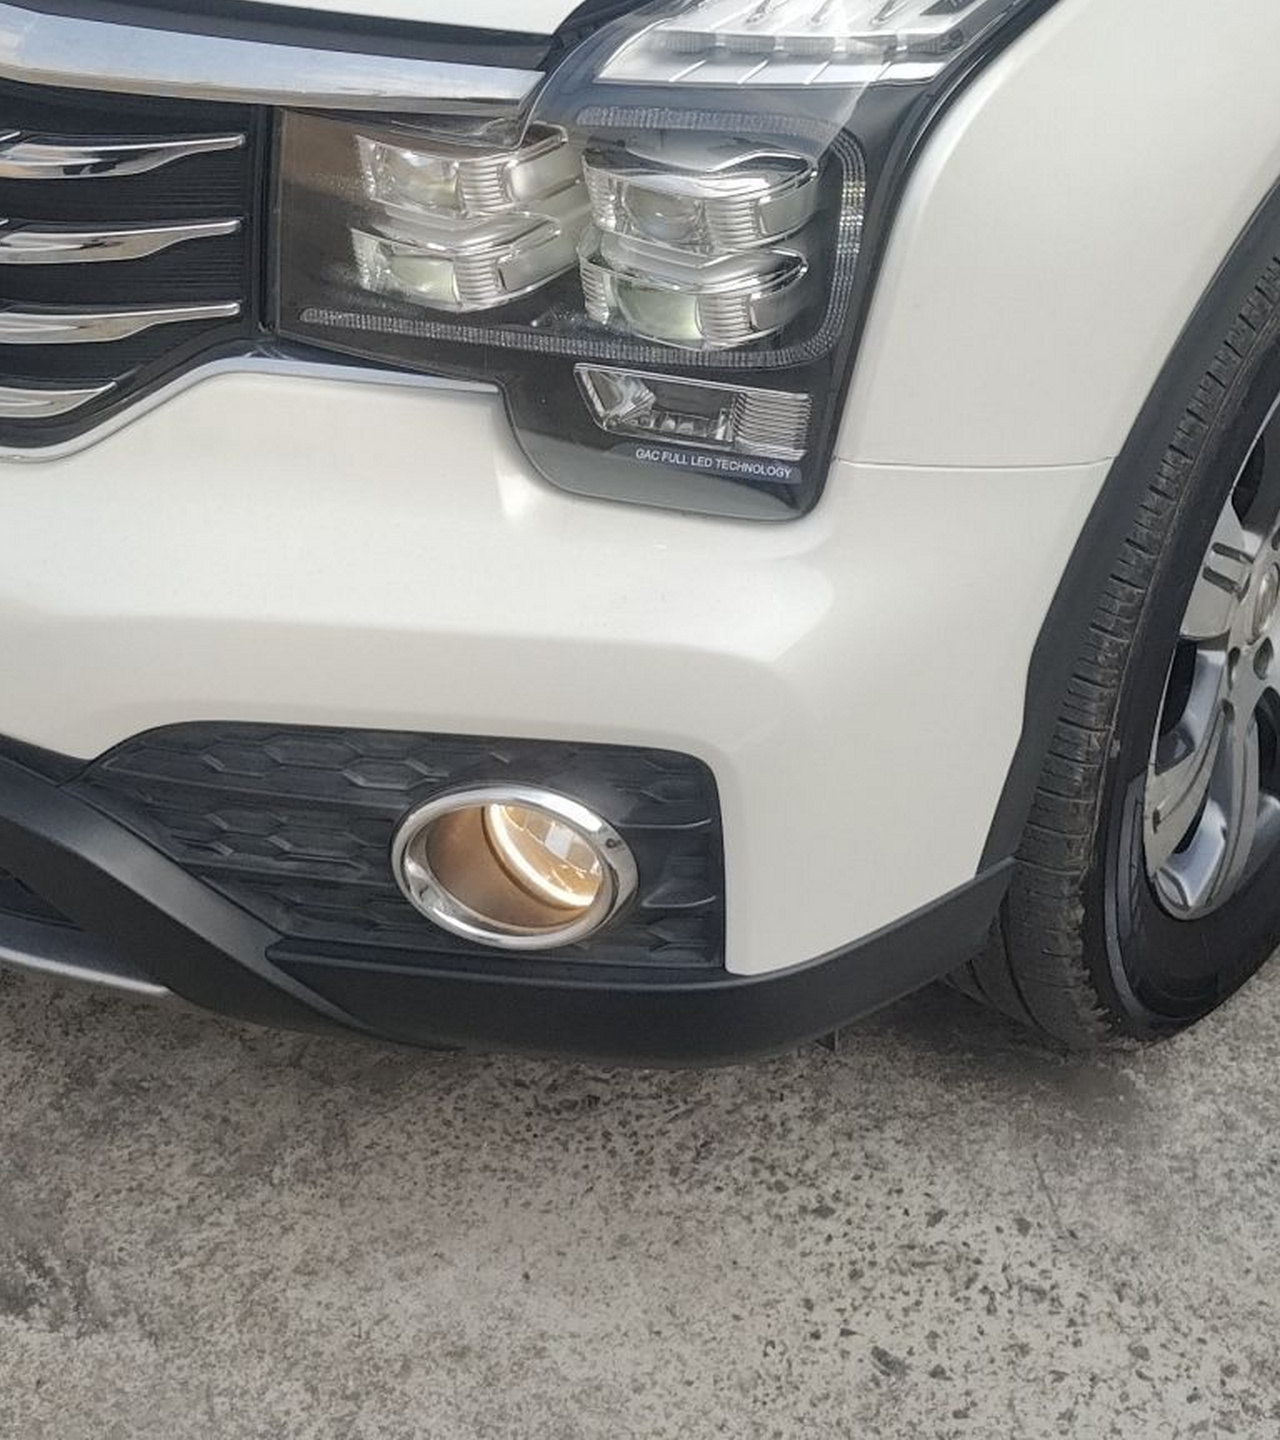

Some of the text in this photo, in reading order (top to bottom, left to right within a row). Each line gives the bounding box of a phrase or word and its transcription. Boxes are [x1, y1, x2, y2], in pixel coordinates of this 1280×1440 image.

[635, 447, 792, 479] GAC FULL LED TECHNOLOGY
